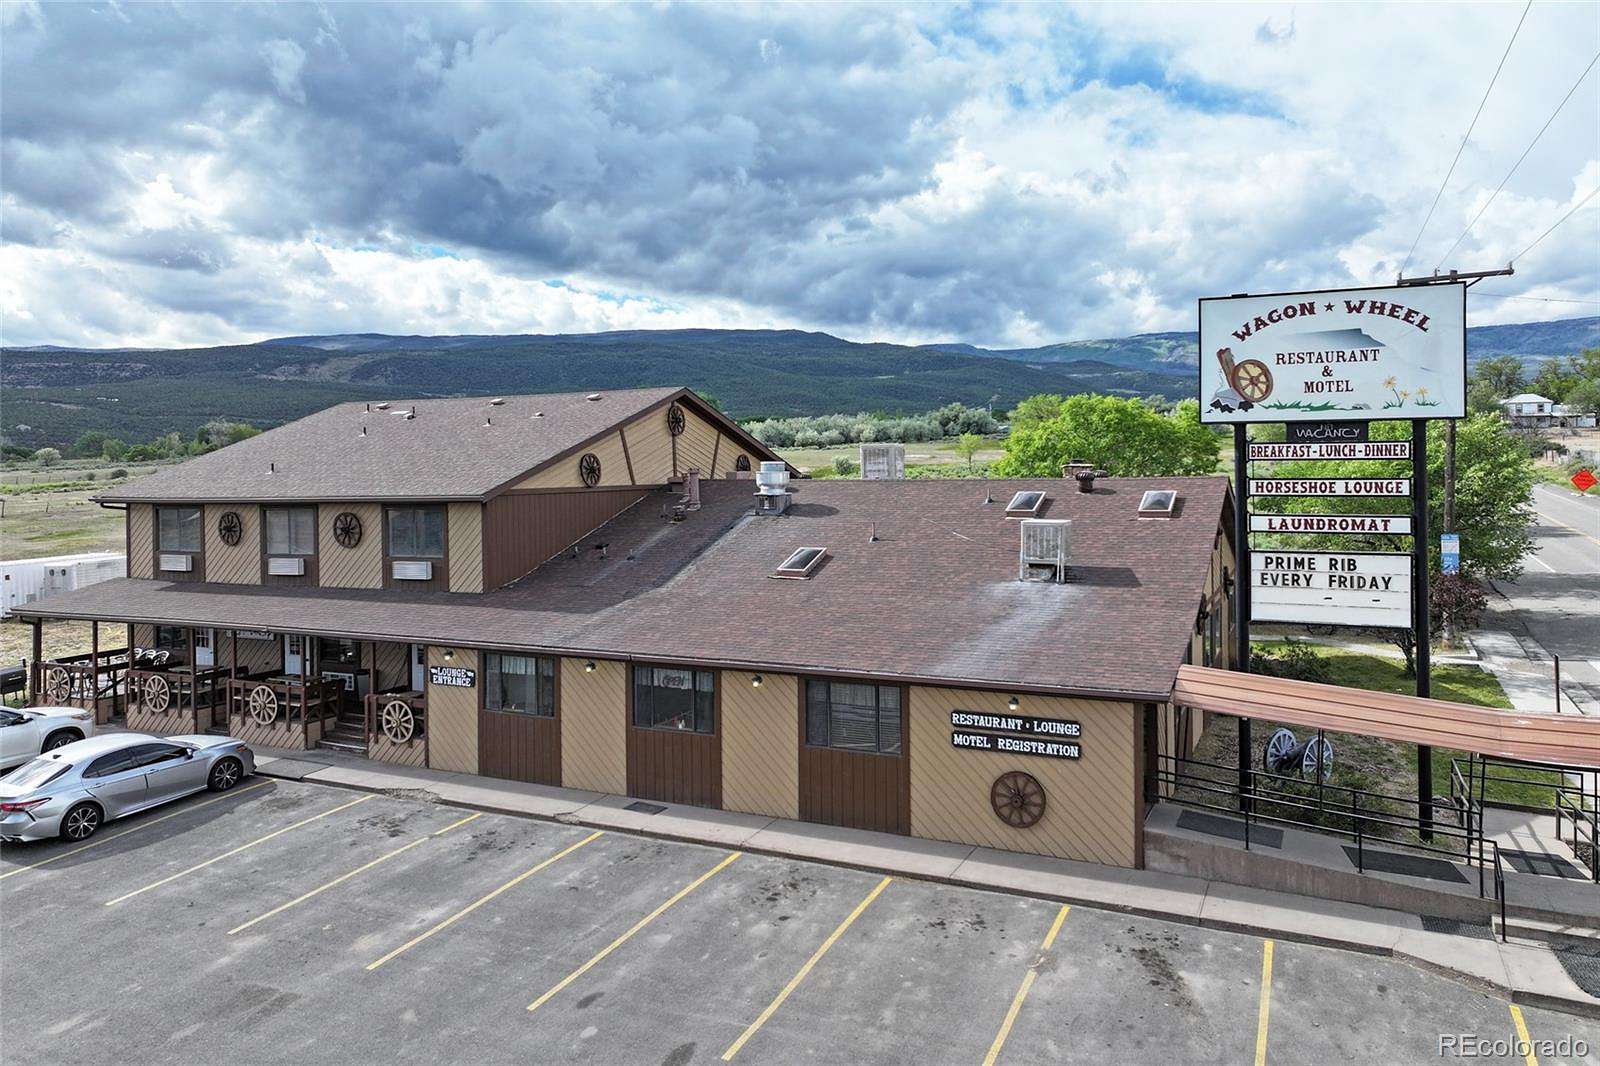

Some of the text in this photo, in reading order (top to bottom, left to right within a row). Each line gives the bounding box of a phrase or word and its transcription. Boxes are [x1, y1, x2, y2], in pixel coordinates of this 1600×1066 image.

[1231, 300, 1432, 342] WAGON WHEEL
[1276, 349, 1380, 365] RESTAURANT
[1321, 366, 1333, 377] &
[1303, 380, 1354, 394] MOTEL
[1296, 428, 1360, 438] VACANCY
[1255, 481, 1403, 494] HORSESHOE LOUNGE
[1267, 518, 1391, 531] LAUNDROMAT
[1264, 556, 1358, 571] PRIME RIB
[1260, 573, 1392, 590] EVERY FRIDAY
[437, 667, 467, 678] LOUNGE
[432, 675, 471, 687] ENTRANCE
[952, 713, 1080, 736] RESTAURANT LOUNGE
[953, 733, 1079, 757] MOTEL REGISTRATION
